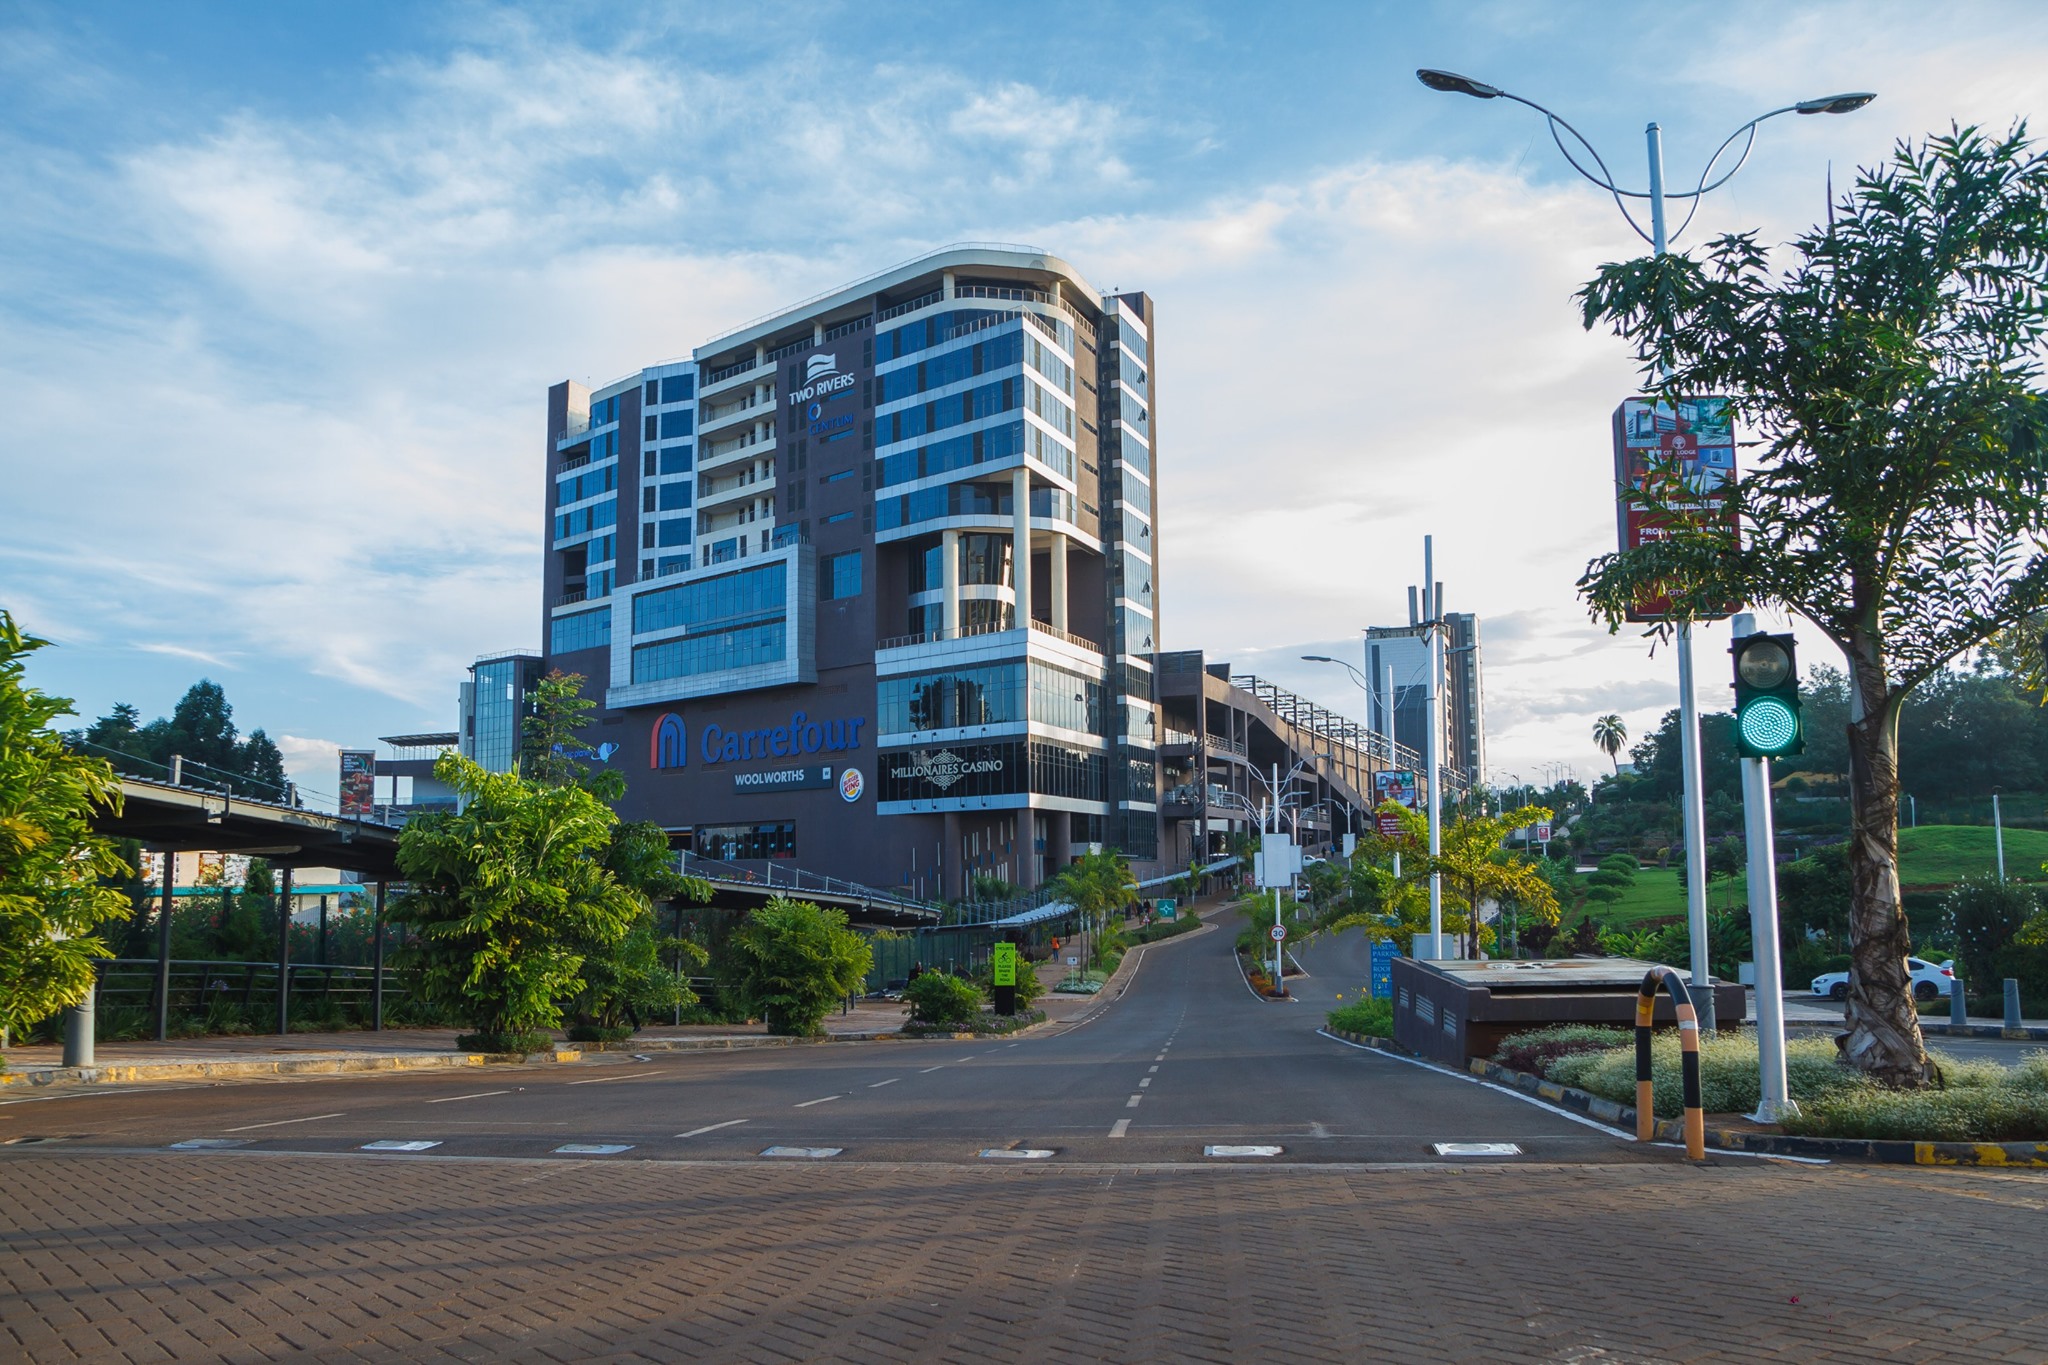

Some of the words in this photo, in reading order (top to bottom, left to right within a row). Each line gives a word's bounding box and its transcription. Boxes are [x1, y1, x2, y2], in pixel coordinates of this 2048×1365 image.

[789, 387, 814, 405] TWO
[817, 373, 854, 395] RIVERS
[809, 414, 853, 435] CENTUM
[702, 711, 864, 763] Carrefour
[735, 769, 804, 786] WOOLWORTHS
[891, 763, 958, 779] MILLIONAIRES
[961, 760, 1003, 773] CASINO
[844, 774, 859, 785] BURGER
[844, 780, 860, 794] KING
